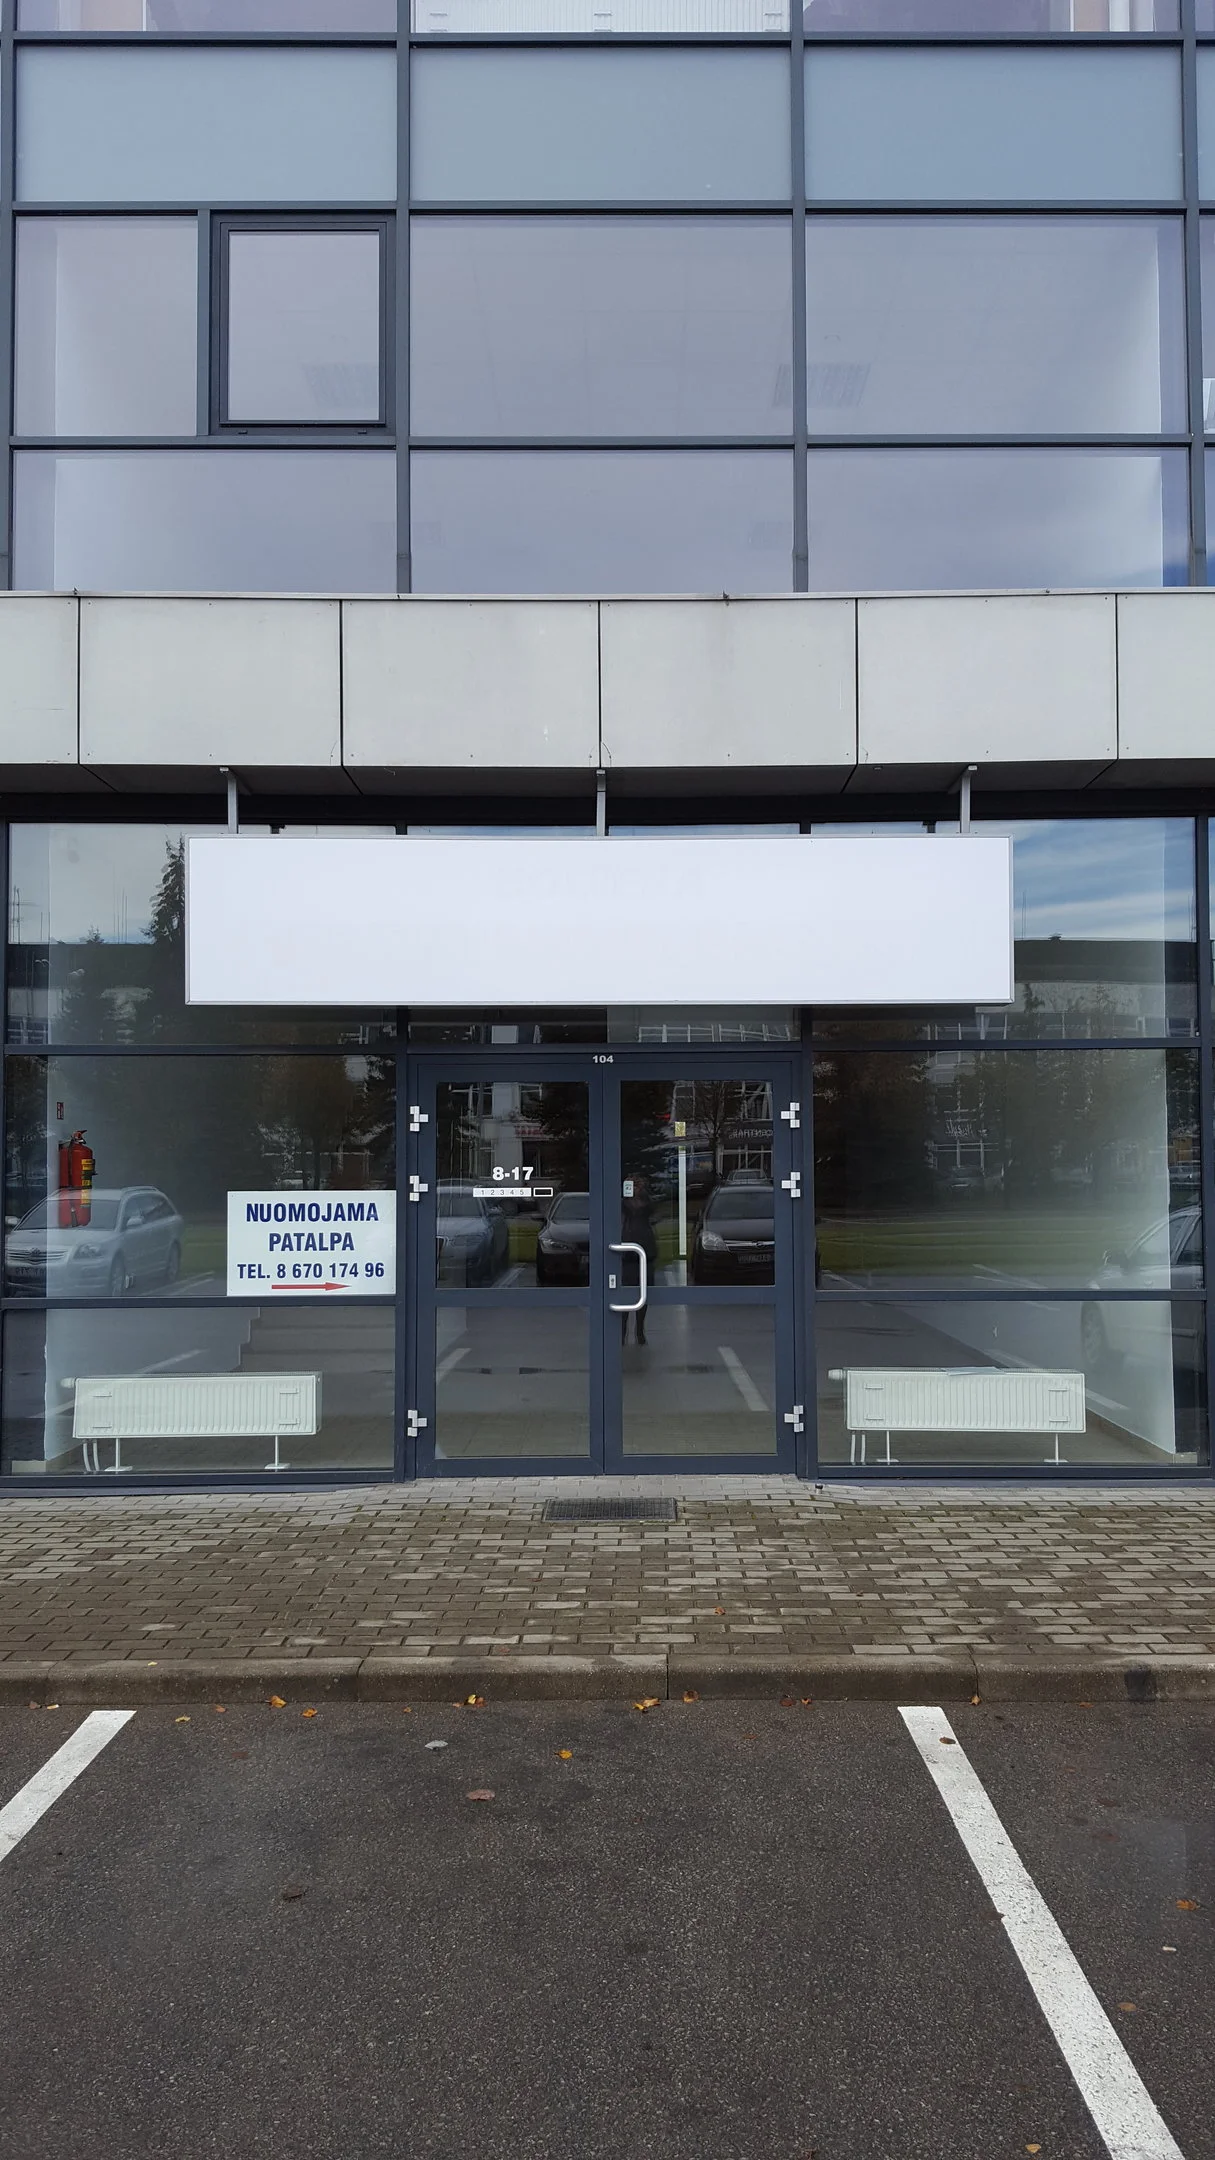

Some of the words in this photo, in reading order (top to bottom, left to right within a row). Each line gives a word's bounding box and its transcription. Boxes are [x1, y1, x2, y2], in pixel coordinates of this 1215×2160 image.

[592, 1055, 614, 1064] 104
[492, 1166, 534, 1181] 8-17
[246, 1202, 379, 1223] NUOMOJAMA
[268, 1232, 355, 1252] PATALPA
[237, 1263, 271, 1279] TEL.
[276, 1263, 287, 1279] 8
[292, 1262, 323, 1279] 670
[328, 1262, 359, 1278] 174
[364, 1262, 385, 1278] 96
